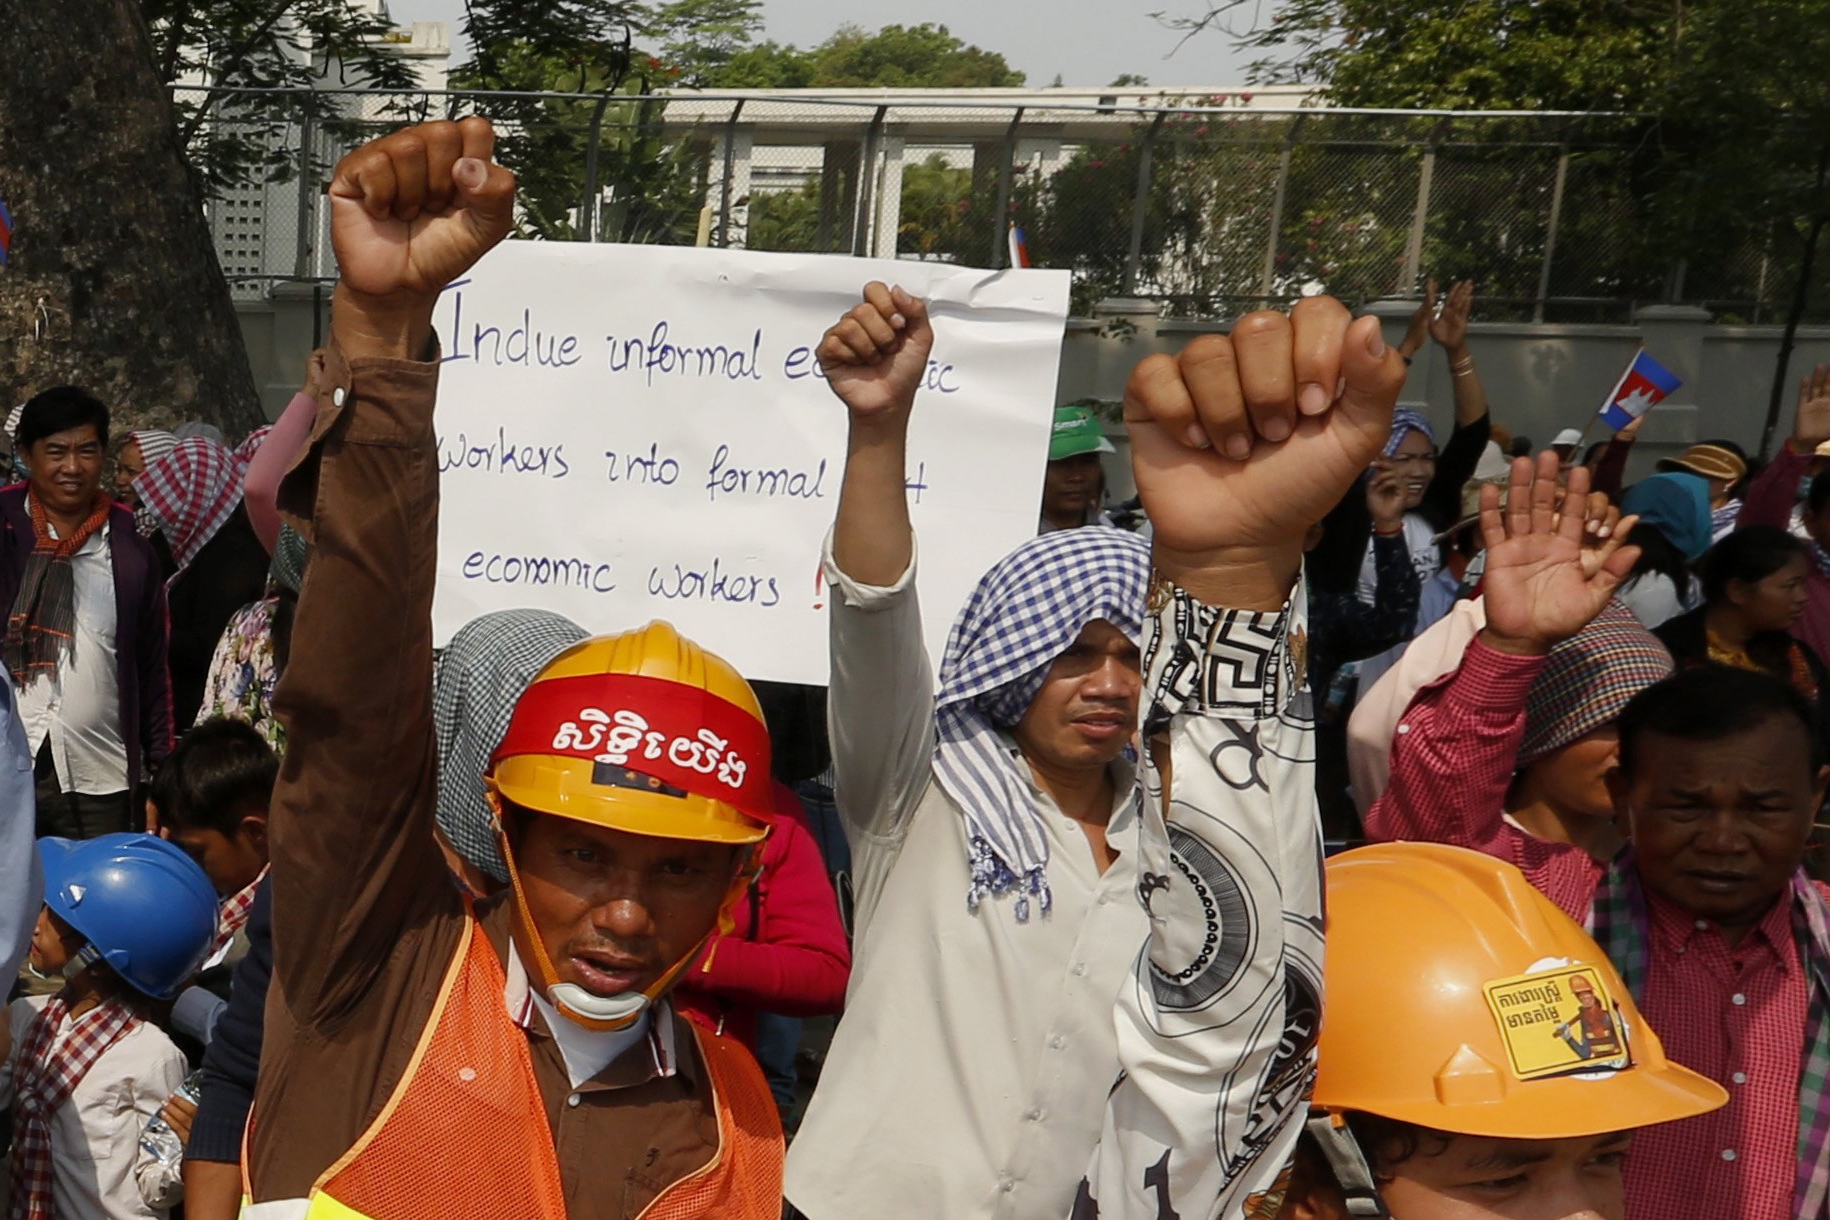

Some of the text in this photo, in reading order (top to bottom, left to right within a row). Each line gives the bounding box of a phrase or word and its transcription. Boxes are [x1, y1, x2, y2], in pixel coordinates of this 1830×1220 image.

[440, 280, 583, 367] Indue
[606, 321, 762, 387] informal
[606, 442, 680, 486] into
[706, 444, 827, 501] formal
[648, 556, 781, 607] workers
